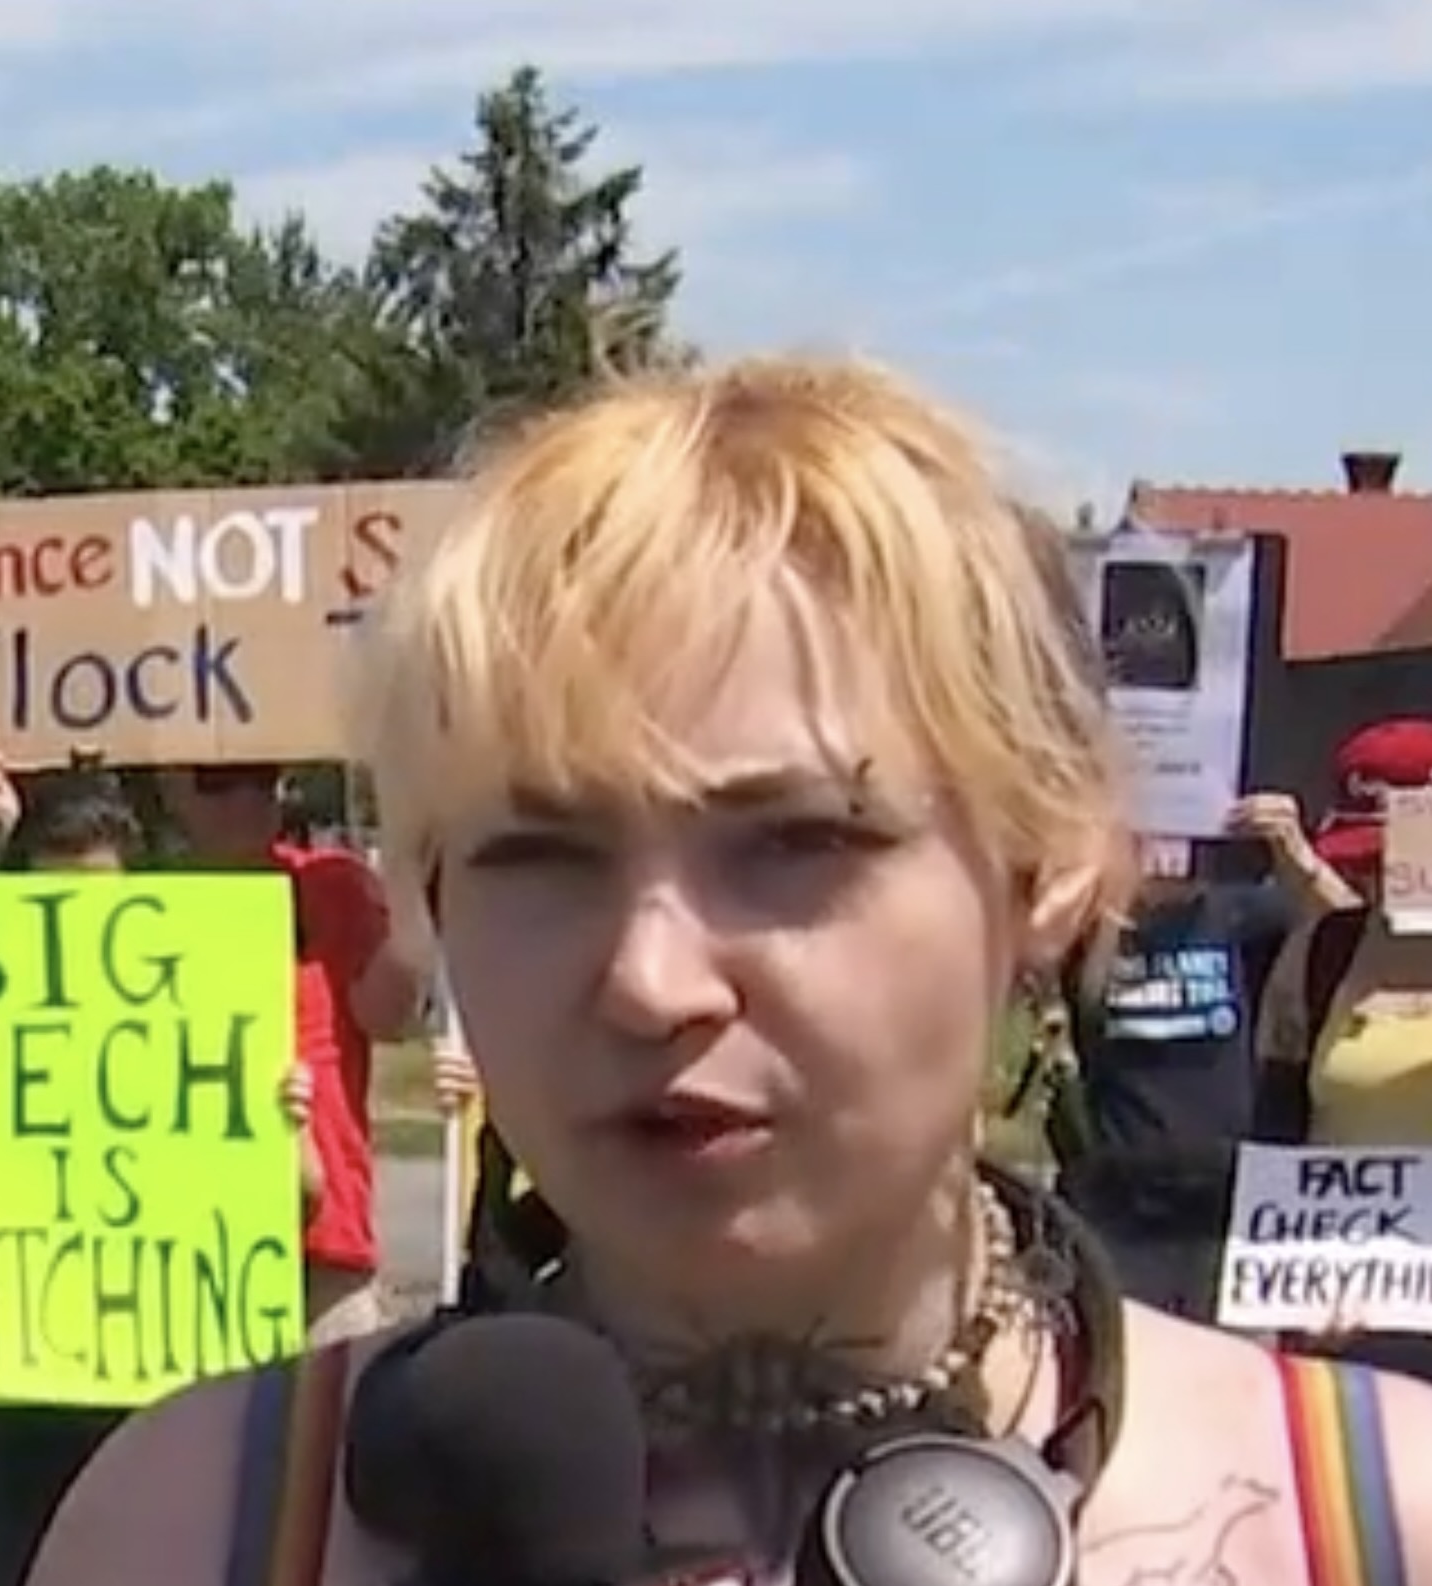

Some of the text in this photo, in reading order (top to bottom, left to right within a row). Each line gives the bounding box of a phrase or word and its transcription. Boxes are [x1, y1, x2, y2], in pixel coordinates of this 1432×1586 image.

[127, 506, 318, 605] NOT
[51, 1145, 144, 1228] IS
[1297, 1156, 1420, 1198] FACT
[1249, 1205, 1422, 1246] CHECK
